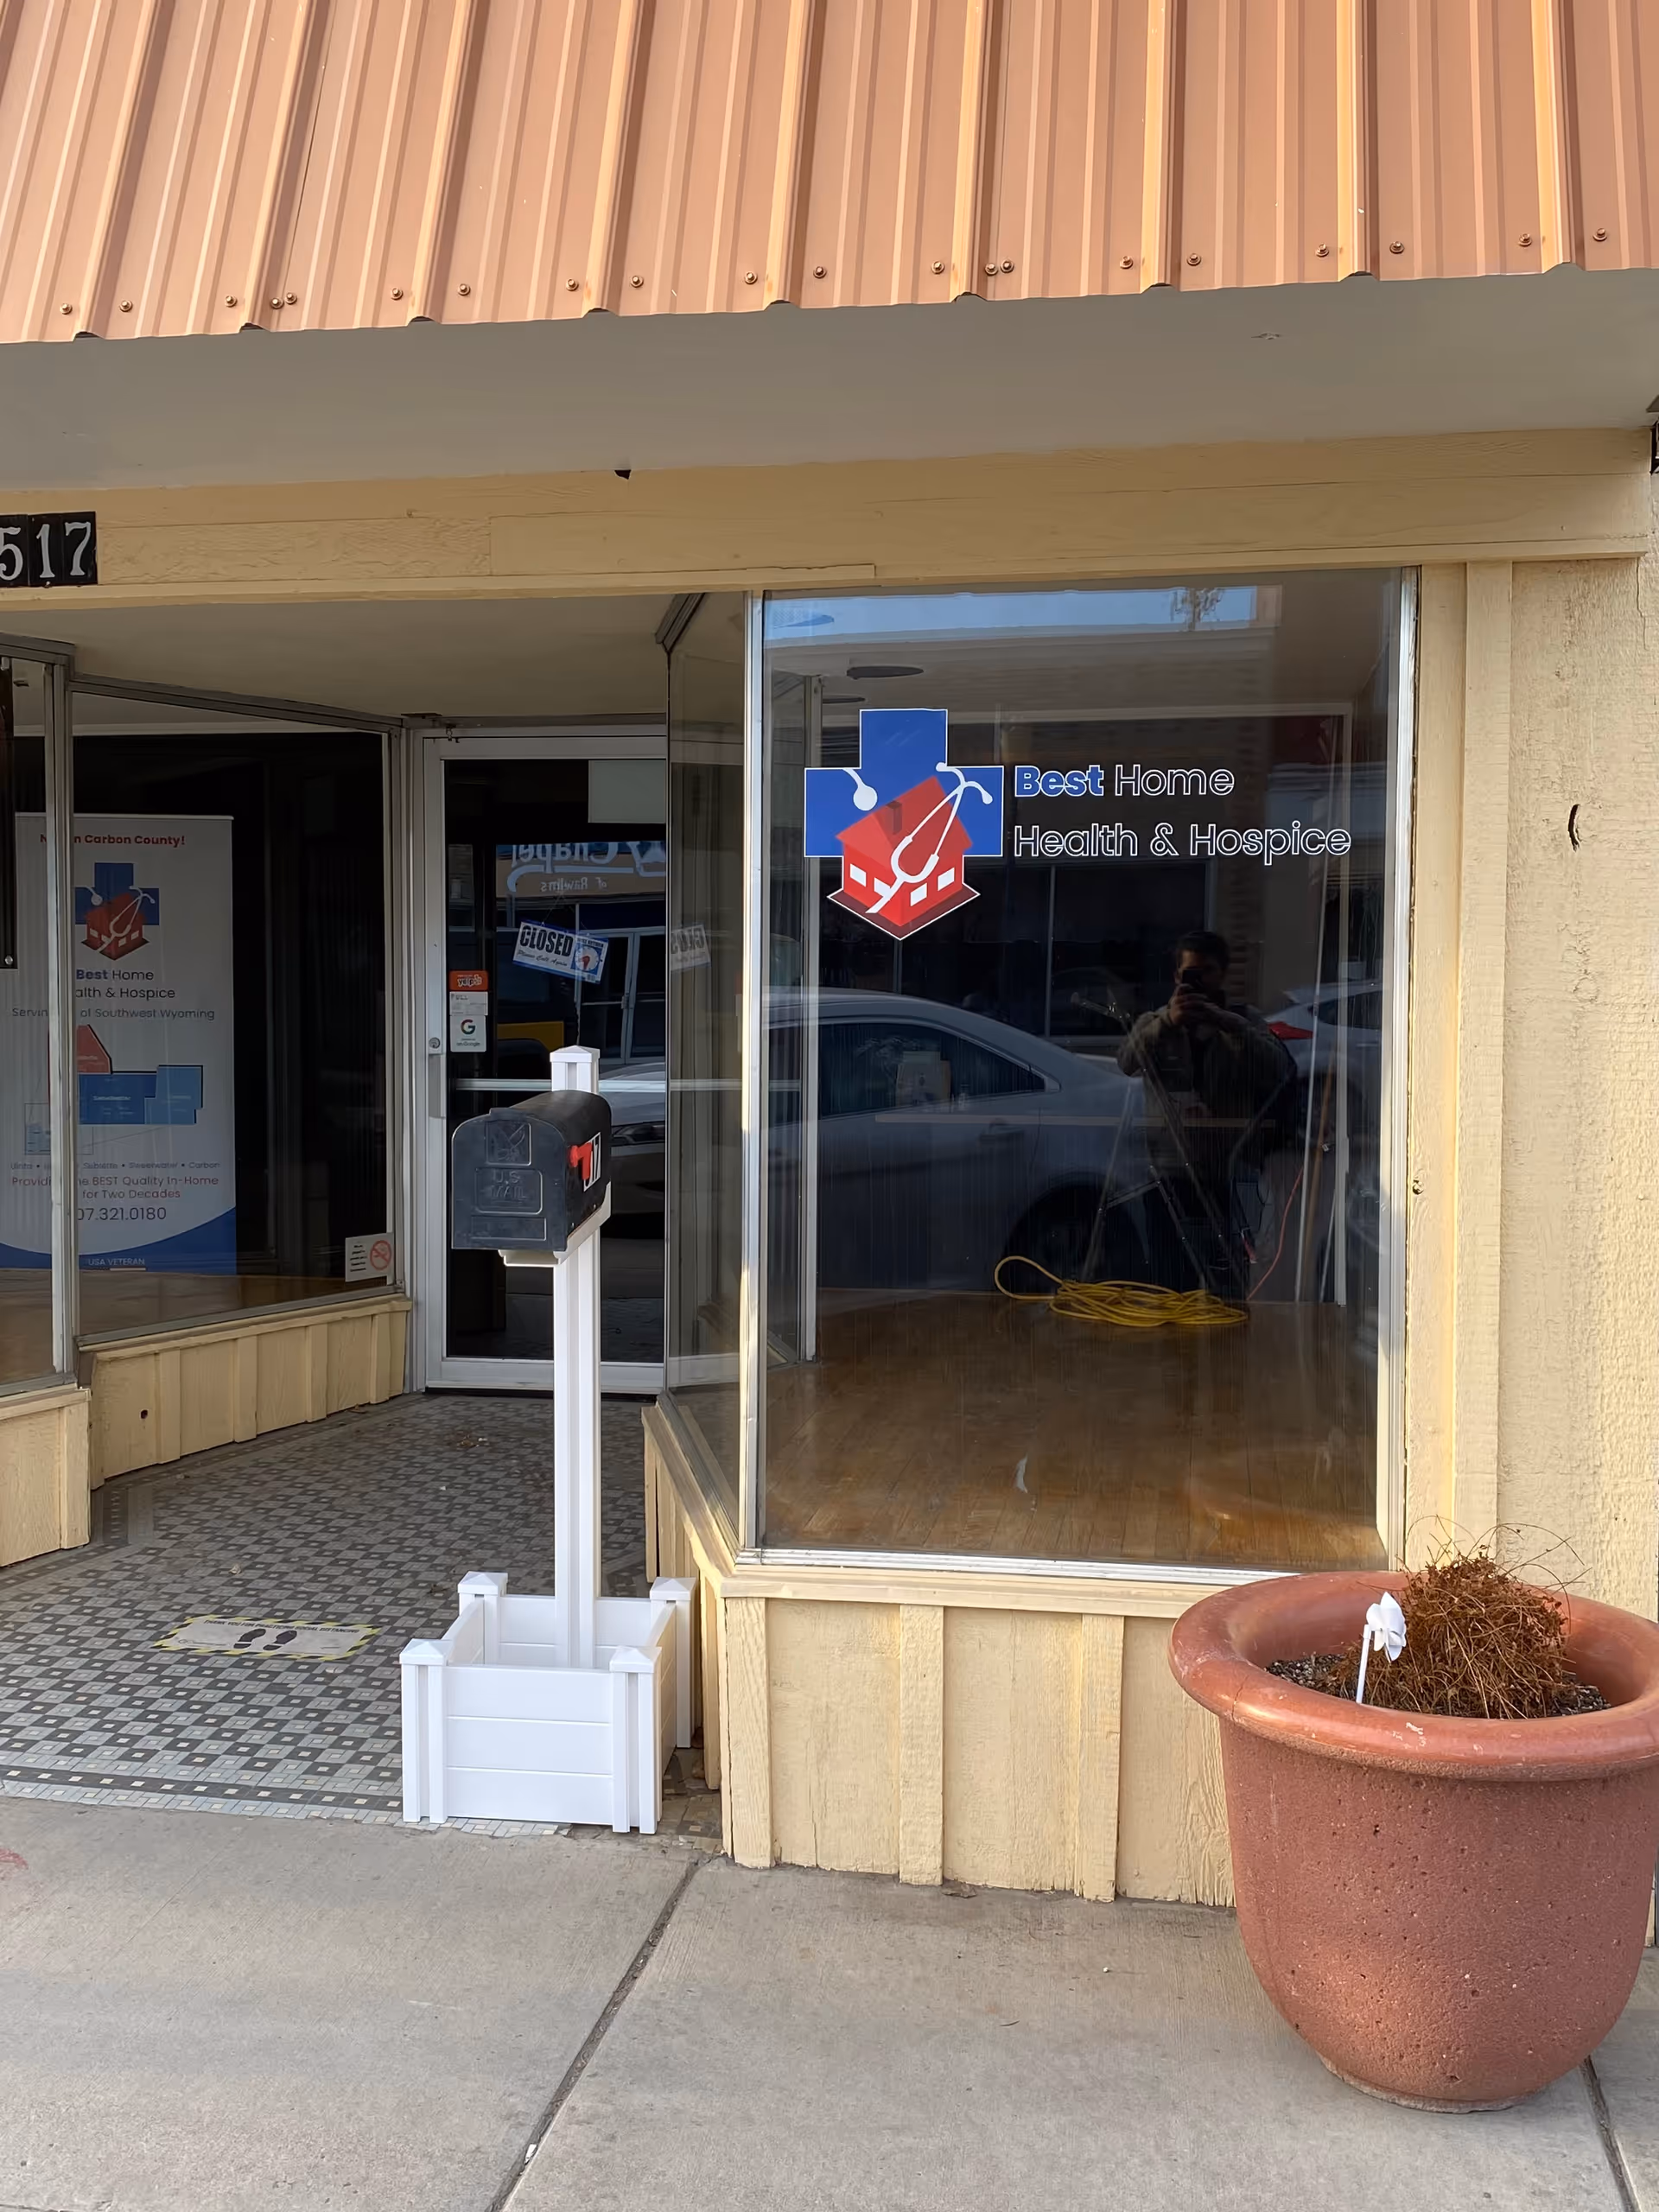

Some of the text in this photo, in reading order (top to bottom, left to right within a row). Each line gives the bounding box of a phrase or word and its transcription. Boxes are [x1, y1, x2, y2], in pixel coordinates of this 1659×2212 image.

[0, 521, 92, 581] 517
[1014, 764, 1235, 797] Best Home
[85, 834, 131, 844] Carbon
[135, 835, 186, 847] County!
[1014, 820, 1351, 866] Health & Hospice
[519, 925, 574, 957] CLOSED
[76, 969, 154, 981] Best Home
[75, 987, 175, 1001] alth & Hospice
[12, 1007, 48, 1018] Servin
[94, 1008, 156, 1019] Southwest
[160, 1009, 215, 1020] Wyoming
[12, 1176, 52, 1186] Providi
[92, 1176, 118, 1186] BEST
[123, 1176, 162, 1190] Quality
[168, 1176, 219, 1186] In-Home
[82, 1190, 181, 1199] for Two Decades
[78, 1207, 167, 1221] 07.321.0180
[88, 1258, 145, 1268] USA VETERAN
